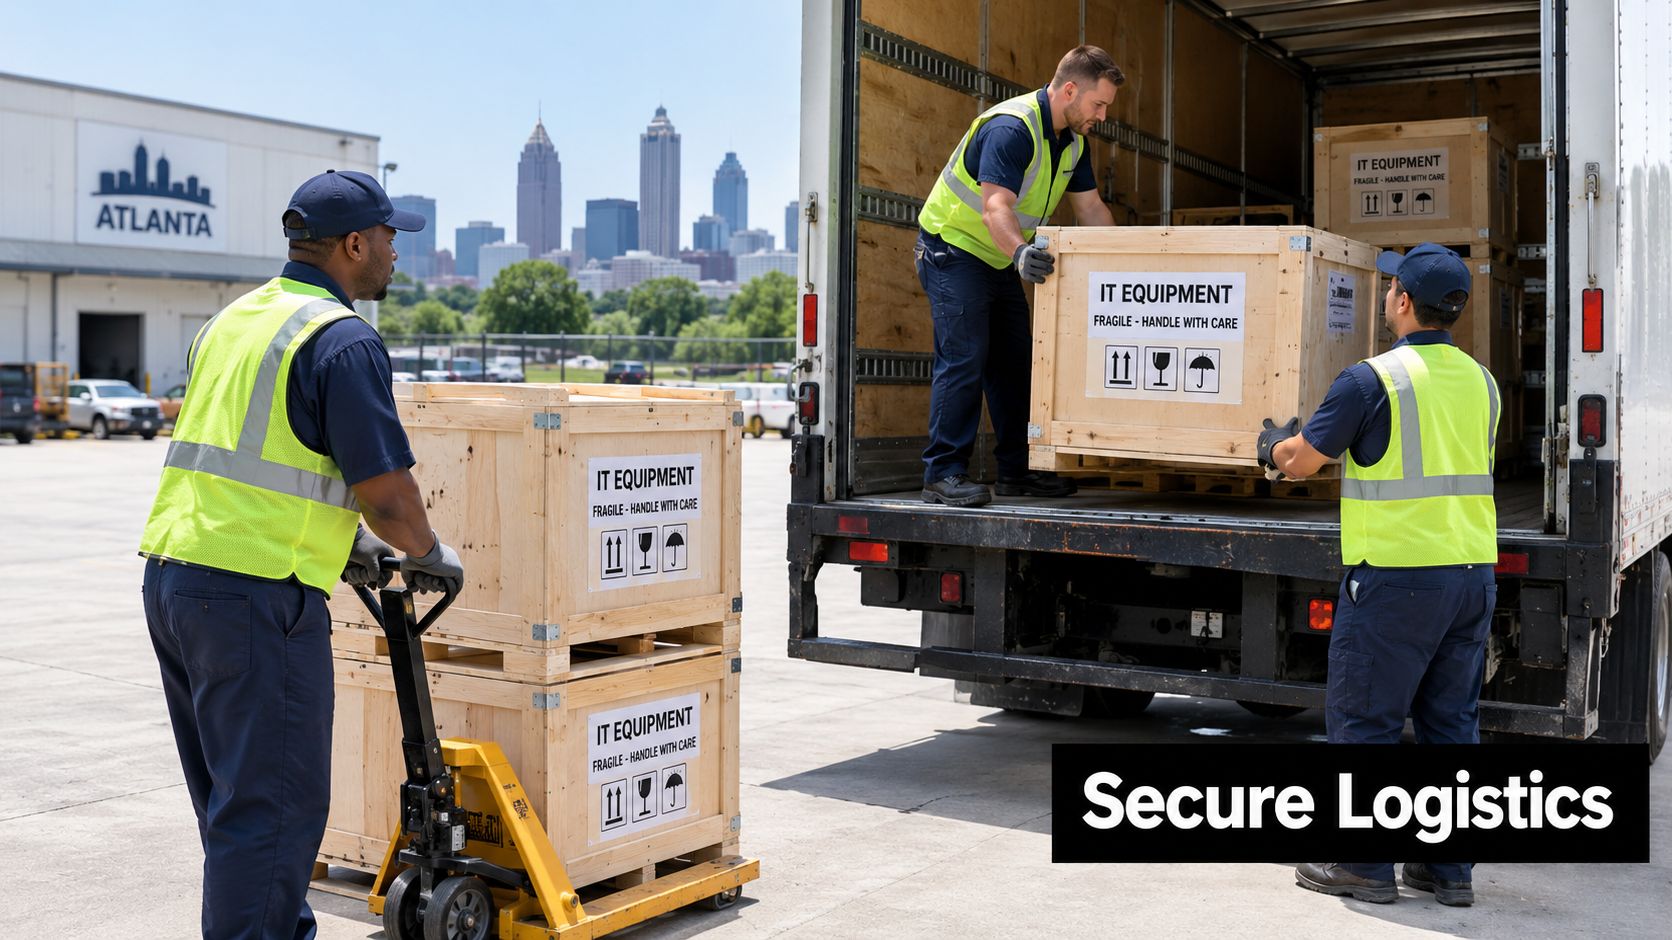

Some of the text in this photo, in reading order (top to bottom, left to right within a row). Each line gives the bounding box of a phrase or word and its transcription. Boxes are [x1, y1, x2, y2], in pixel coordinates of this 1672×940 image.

[1357, 155, 1441, 171] IT EQUIPMENT
[1354, 177, 1378, 185] FRAGILE
[1384, 175, 1409, 184] HANDLE
[1428, 173, 1446, 181] CARE
[96, 204, 212, 237] ATLANTA
[1100, 284, 1232, 304] IT EQUIPMENT
[1094, 315, 1132, 326] FRAGILE
[1142, 316, 1180, 328] HANDLE
[1184, 317, 1208, 328] WITH
[1211, 318, 1238, 329] CARE
[597, 466, 694, 490] IT EQUIPMENT
[592, 504, 624, 518] FRAGILE
[630, 501, 659, 514] HANDLE
[660, 499, 678, 512] WITH
[680, 498, 698, 510] CARE
[597, 706, 692, 746] IT EQUIPMENT
[592, 754, 622, 772] FRAGILE
[630, 746, 658, 763] HANDLE
[660, 741, 677, 756] WITH
[678, 736, 696, 751] CARE
